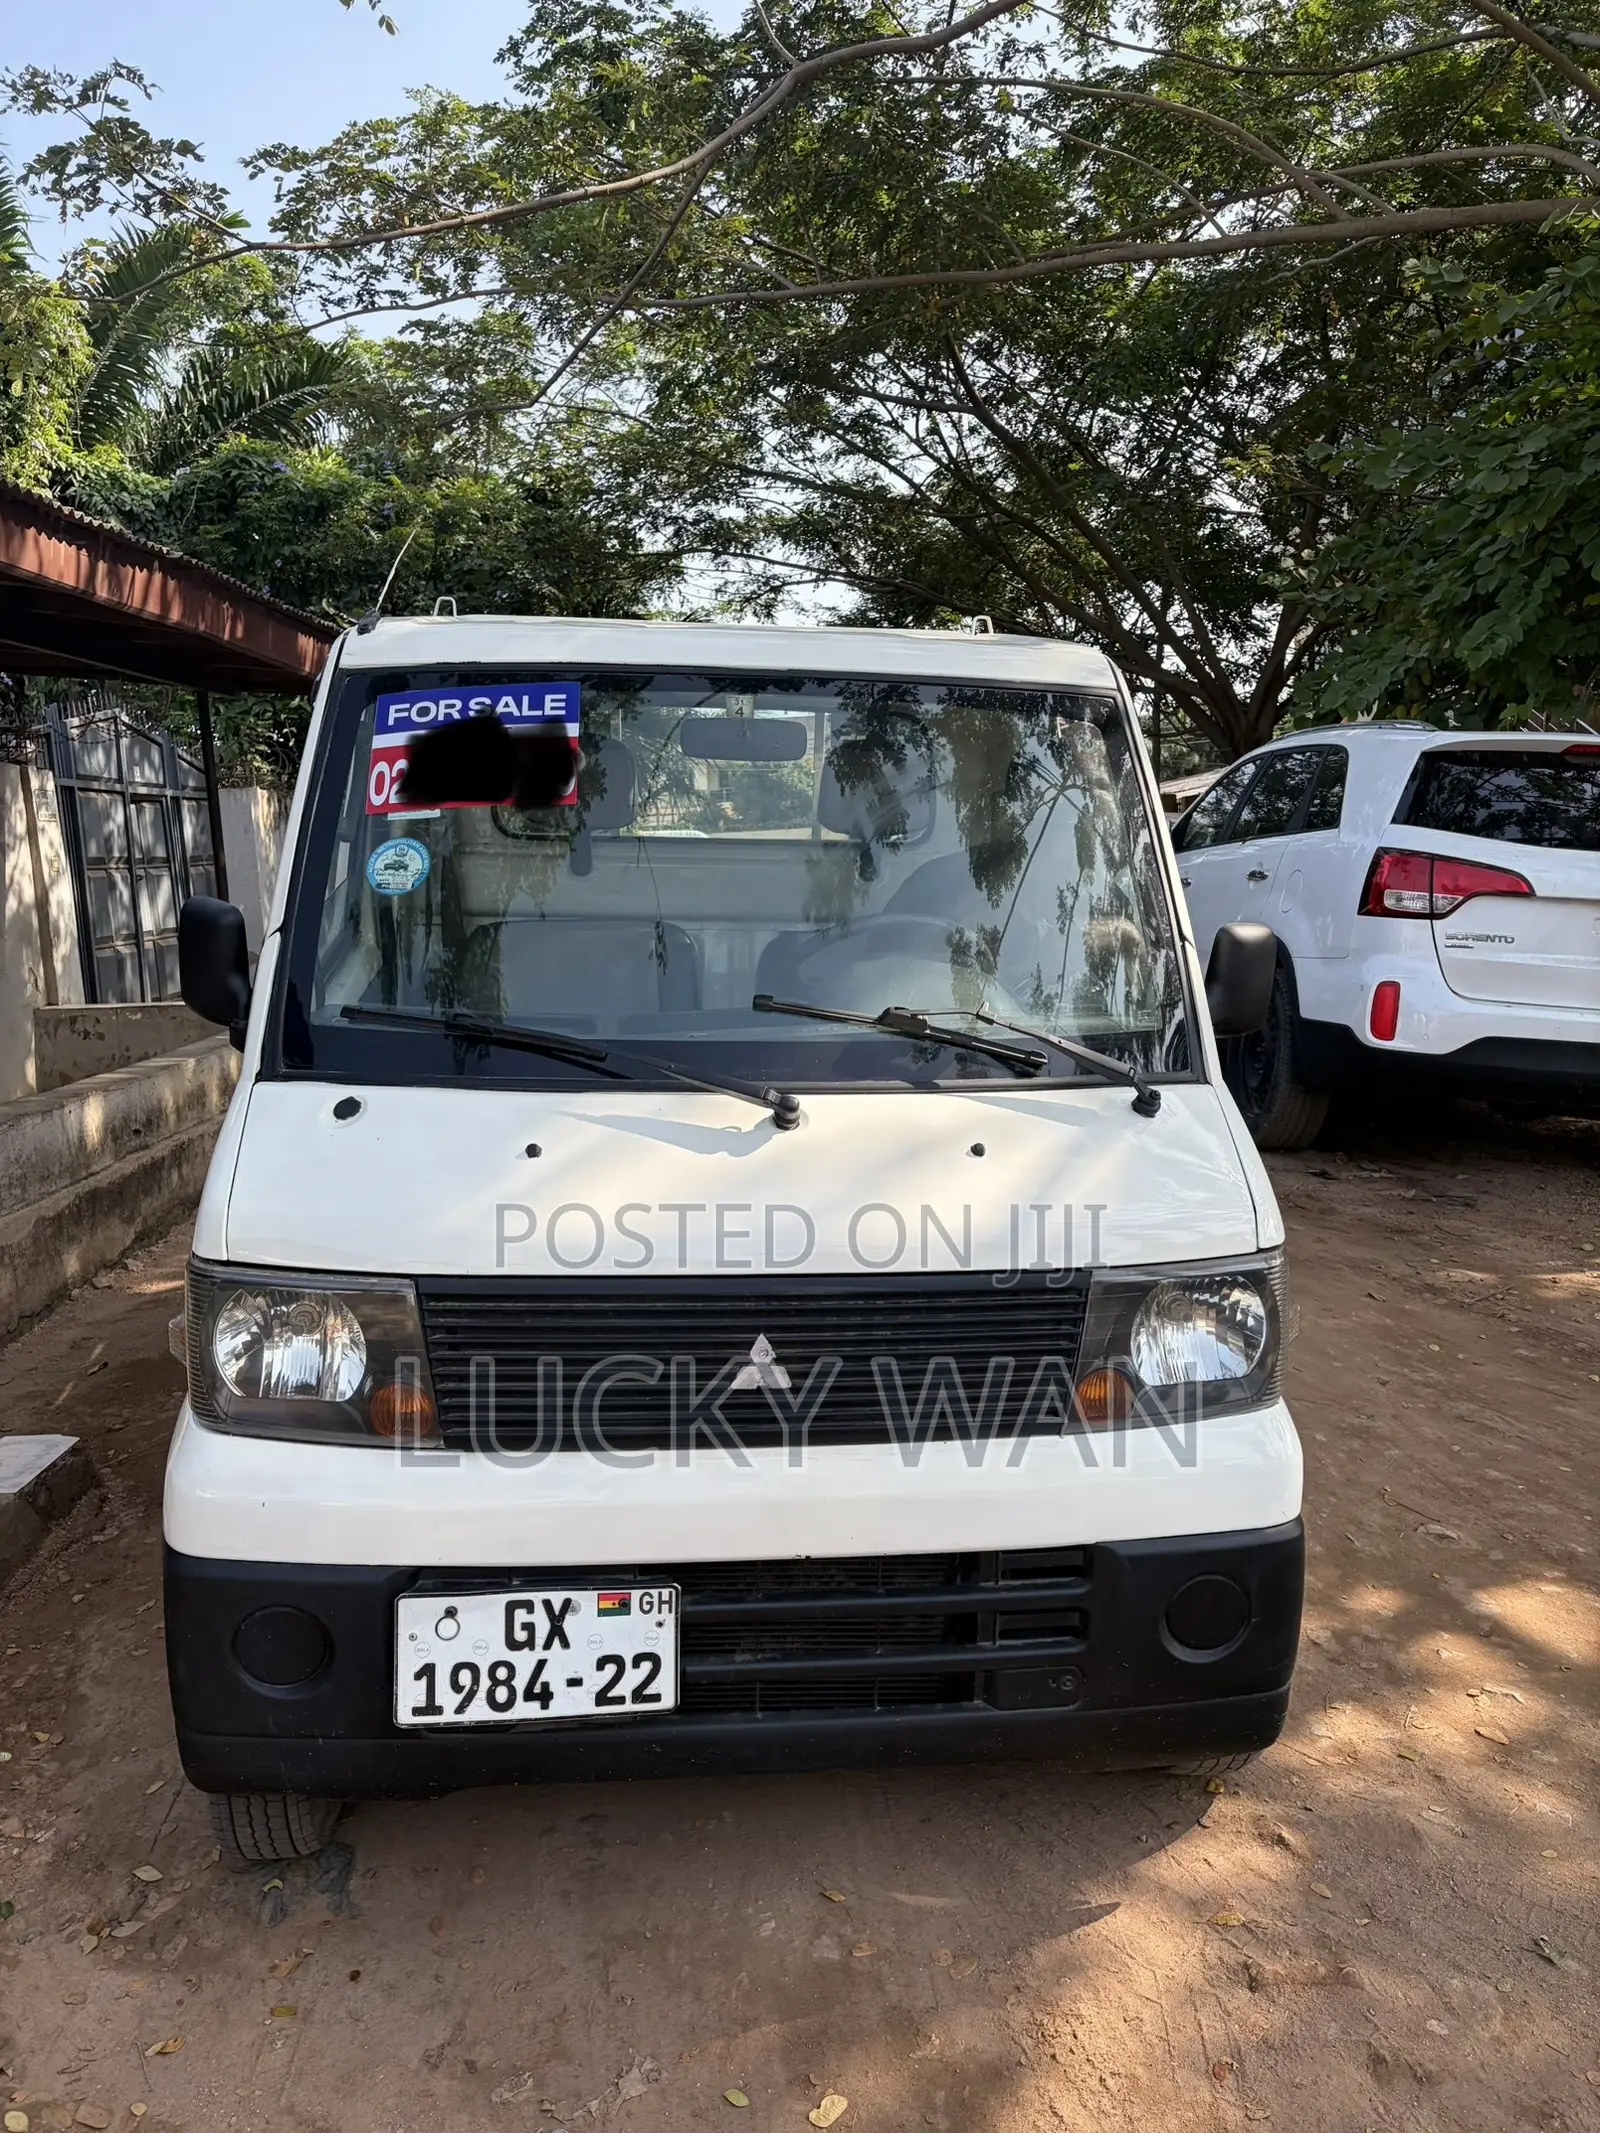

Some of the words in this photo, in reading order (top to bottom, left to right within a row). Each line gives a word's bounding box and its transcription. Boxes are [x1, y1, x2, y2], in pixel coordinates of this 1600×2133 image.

[387, 699, 463, 726] FOR
[468, 694, 567, 718] SALE
[735, 706, 744, 717] 4
[1445, 932, 1515, 944] SORENTO
[639, 1590, 673, 1615] GH
[505, 1597, 573, 1652] GX
[411, 1652, 662, 1717] 1984-22
